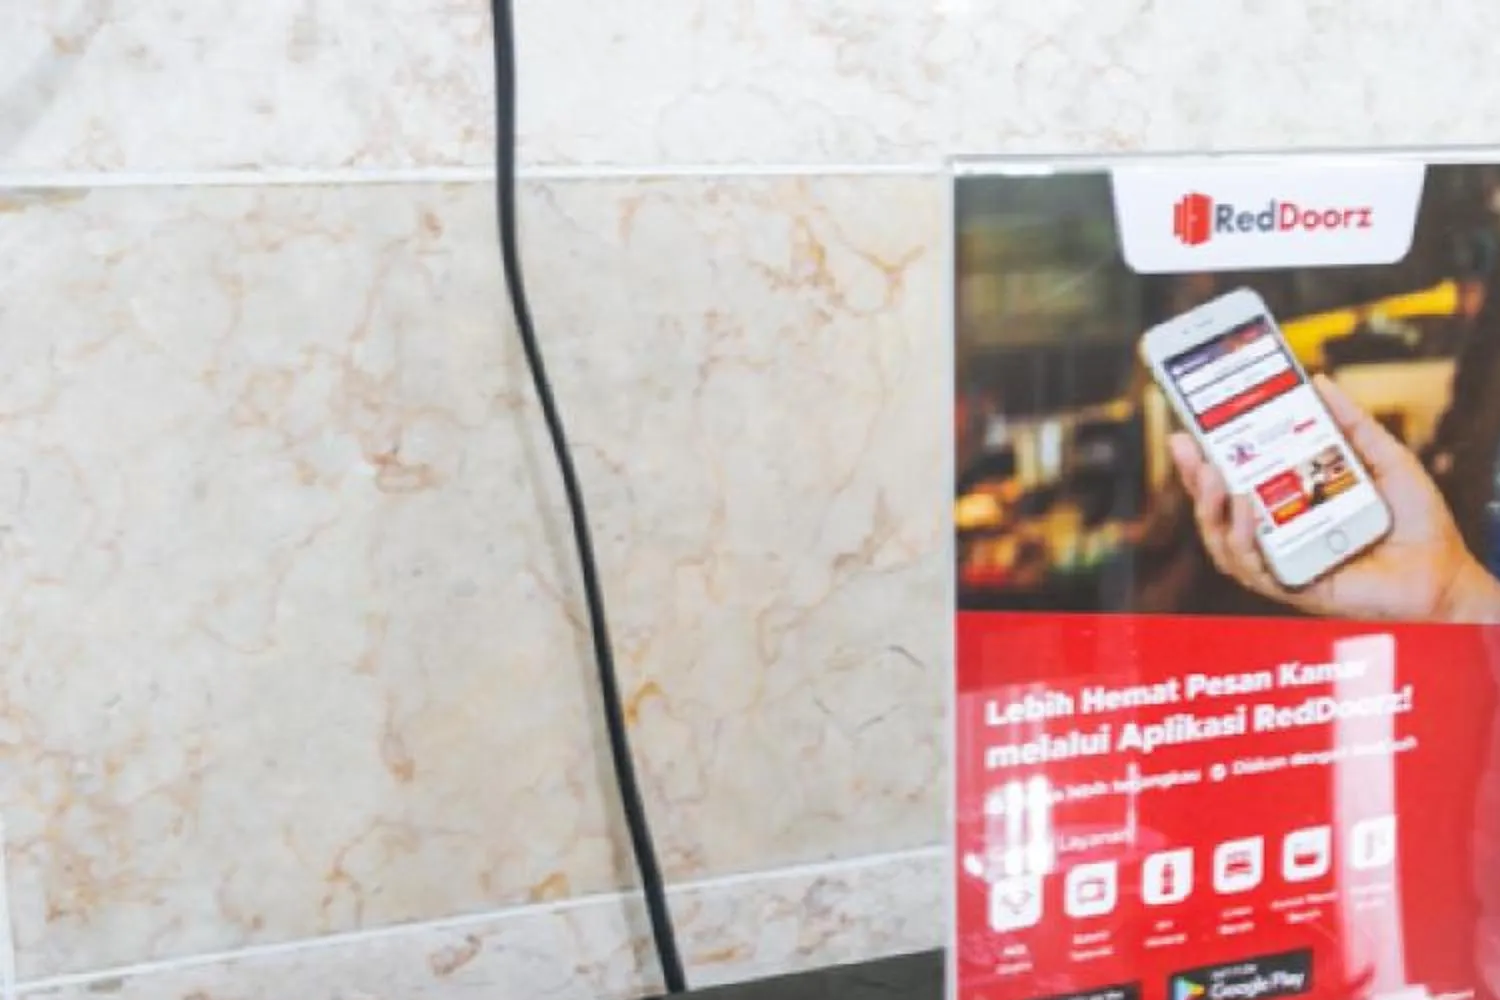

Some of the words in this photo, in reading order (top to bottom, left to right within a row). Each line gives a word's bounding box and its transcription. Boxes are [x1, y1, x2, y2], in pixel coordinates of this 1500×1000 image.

[1214, 198, 1373, 234] RedDoorz
[986, 694, 1074, 727] Lebih
[1081, 681, 1180, 714] Hemat
[1186, 668, 1272, 699] Pesan
[986, 723, 1109, 768] melalui
[1118, 705, 1247, 754] Aplikasi
[1210, 975, 1268, 1000] Google
[1270, 968, 1305, 991] Play
